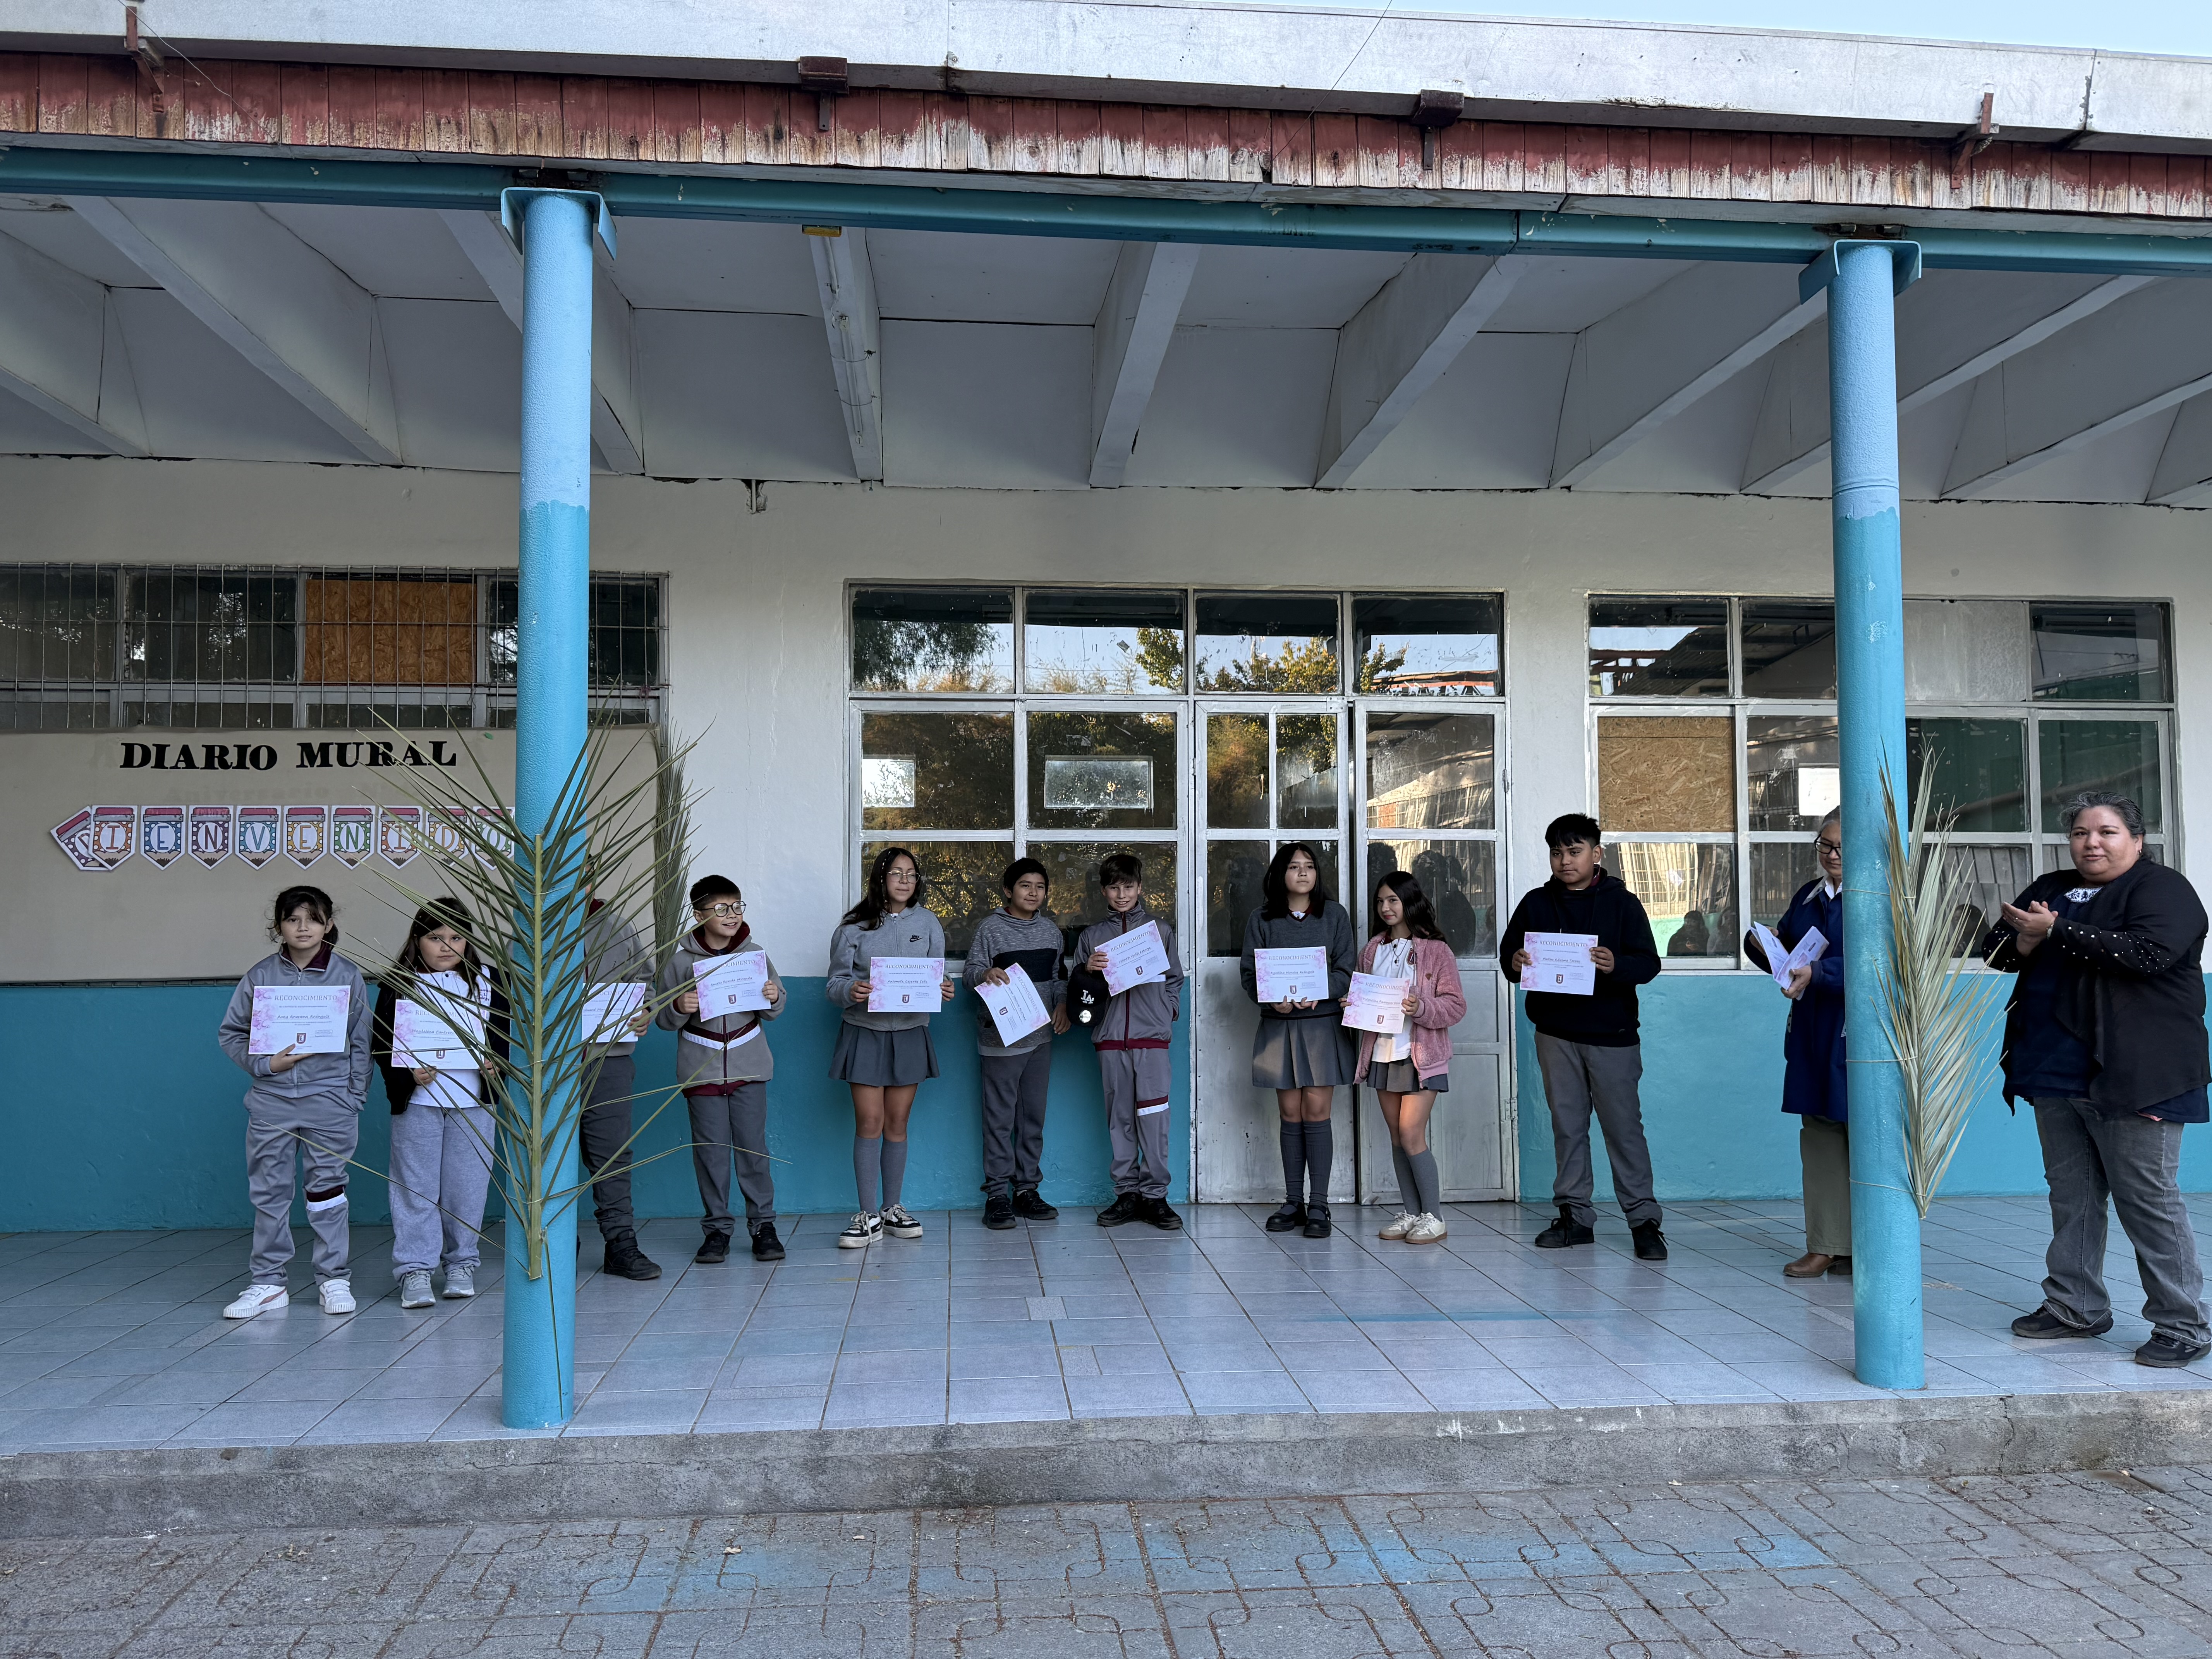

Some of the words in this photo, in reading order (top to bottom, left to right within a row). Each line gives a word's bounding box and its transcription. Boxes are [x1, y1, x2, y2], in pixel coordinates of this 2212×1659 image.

[120, 743, 277, 770] DIARIO
[296, 741, 457, 768] MURAL
[1080, 989, 1094, 1004] LA
